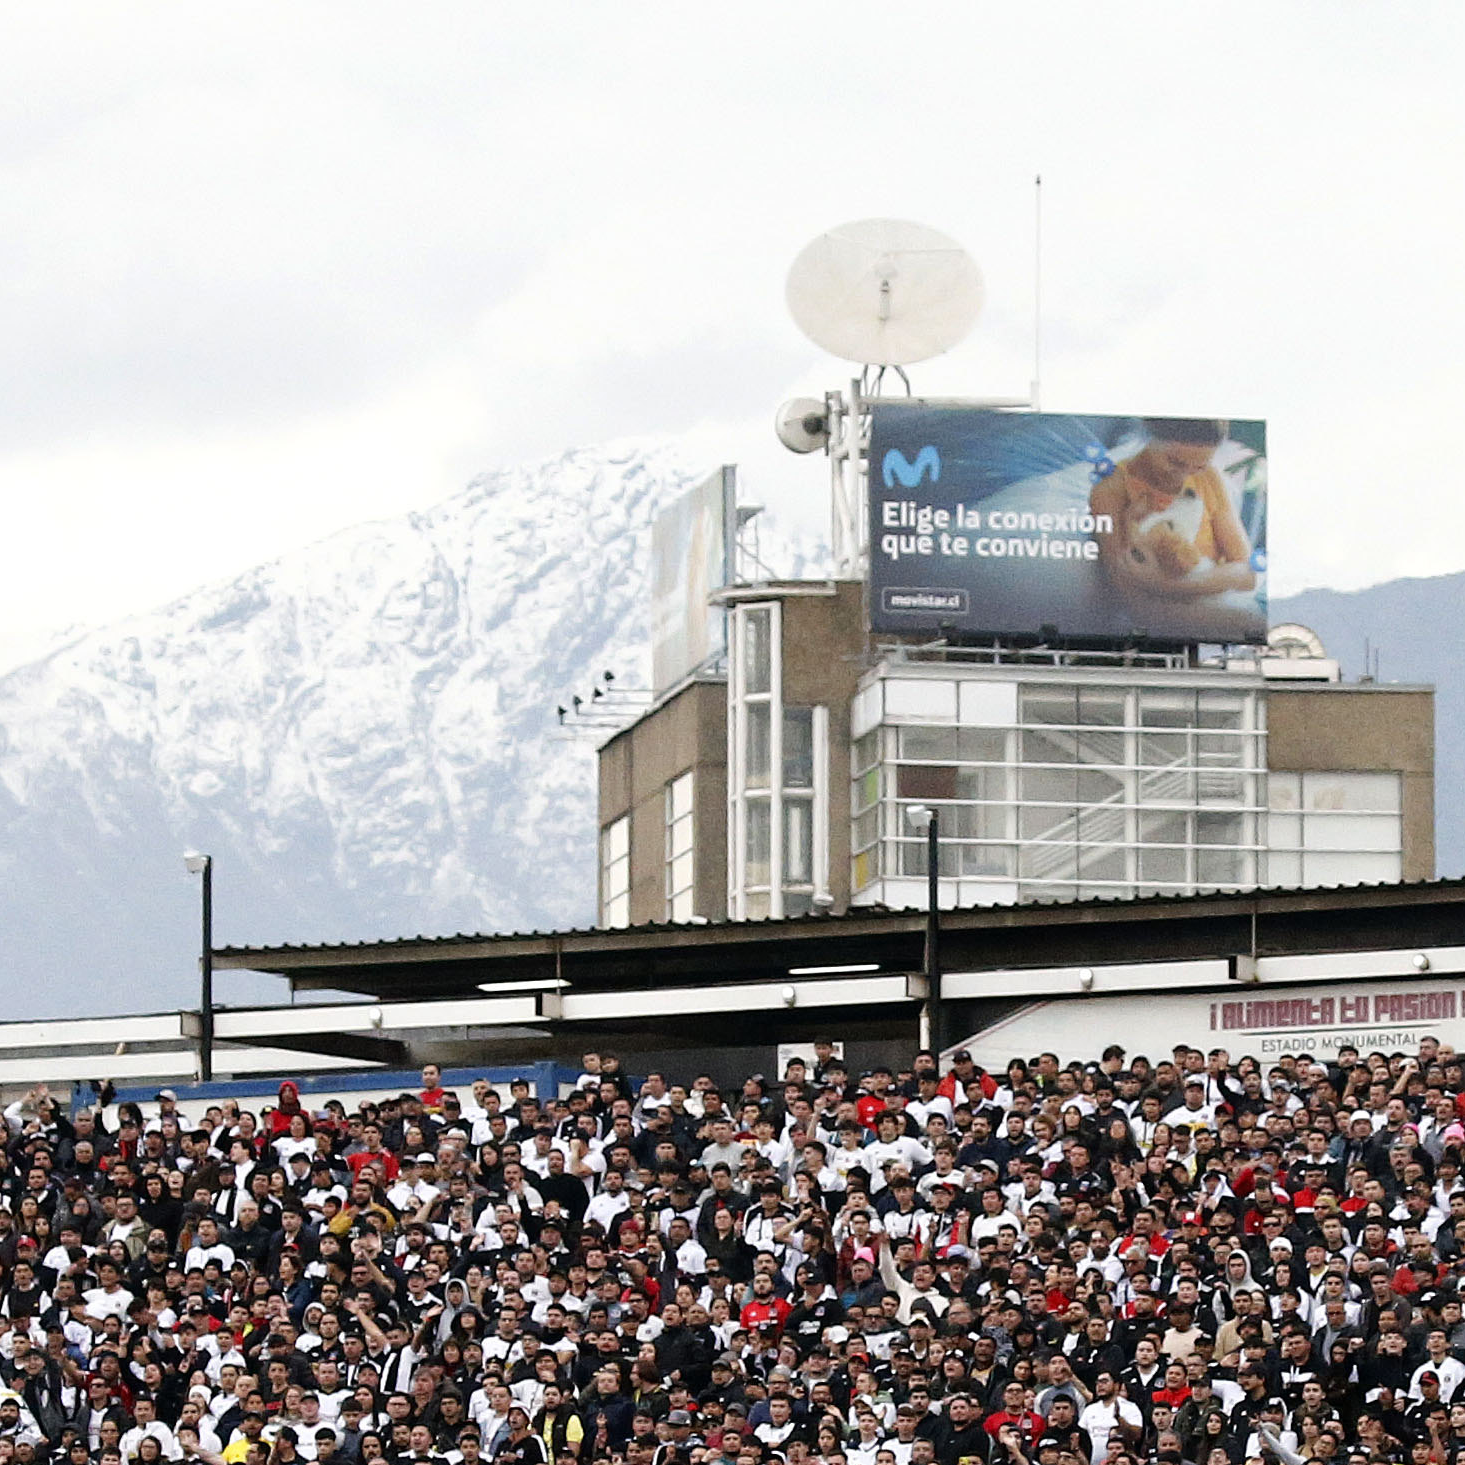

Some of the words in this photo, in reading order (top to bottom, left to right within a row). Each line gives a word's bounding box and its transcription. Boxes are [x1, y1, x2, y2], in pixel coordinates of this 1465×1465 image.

[882, 502, 950, 534] Elige
[957, 502, 985, 529] la
[988, 506, 1114, 533] conexión
[882, 534, 934, 560] que
[941, 533, 968, 556] te
[975, 535, 1099, 560] conviene
[891, 593, 960, 608] movistar.cl
[1262, 1037, 1316, 1053] ESTADIO
[1321, 1033, 1418, 1049] MONUMENTAL
